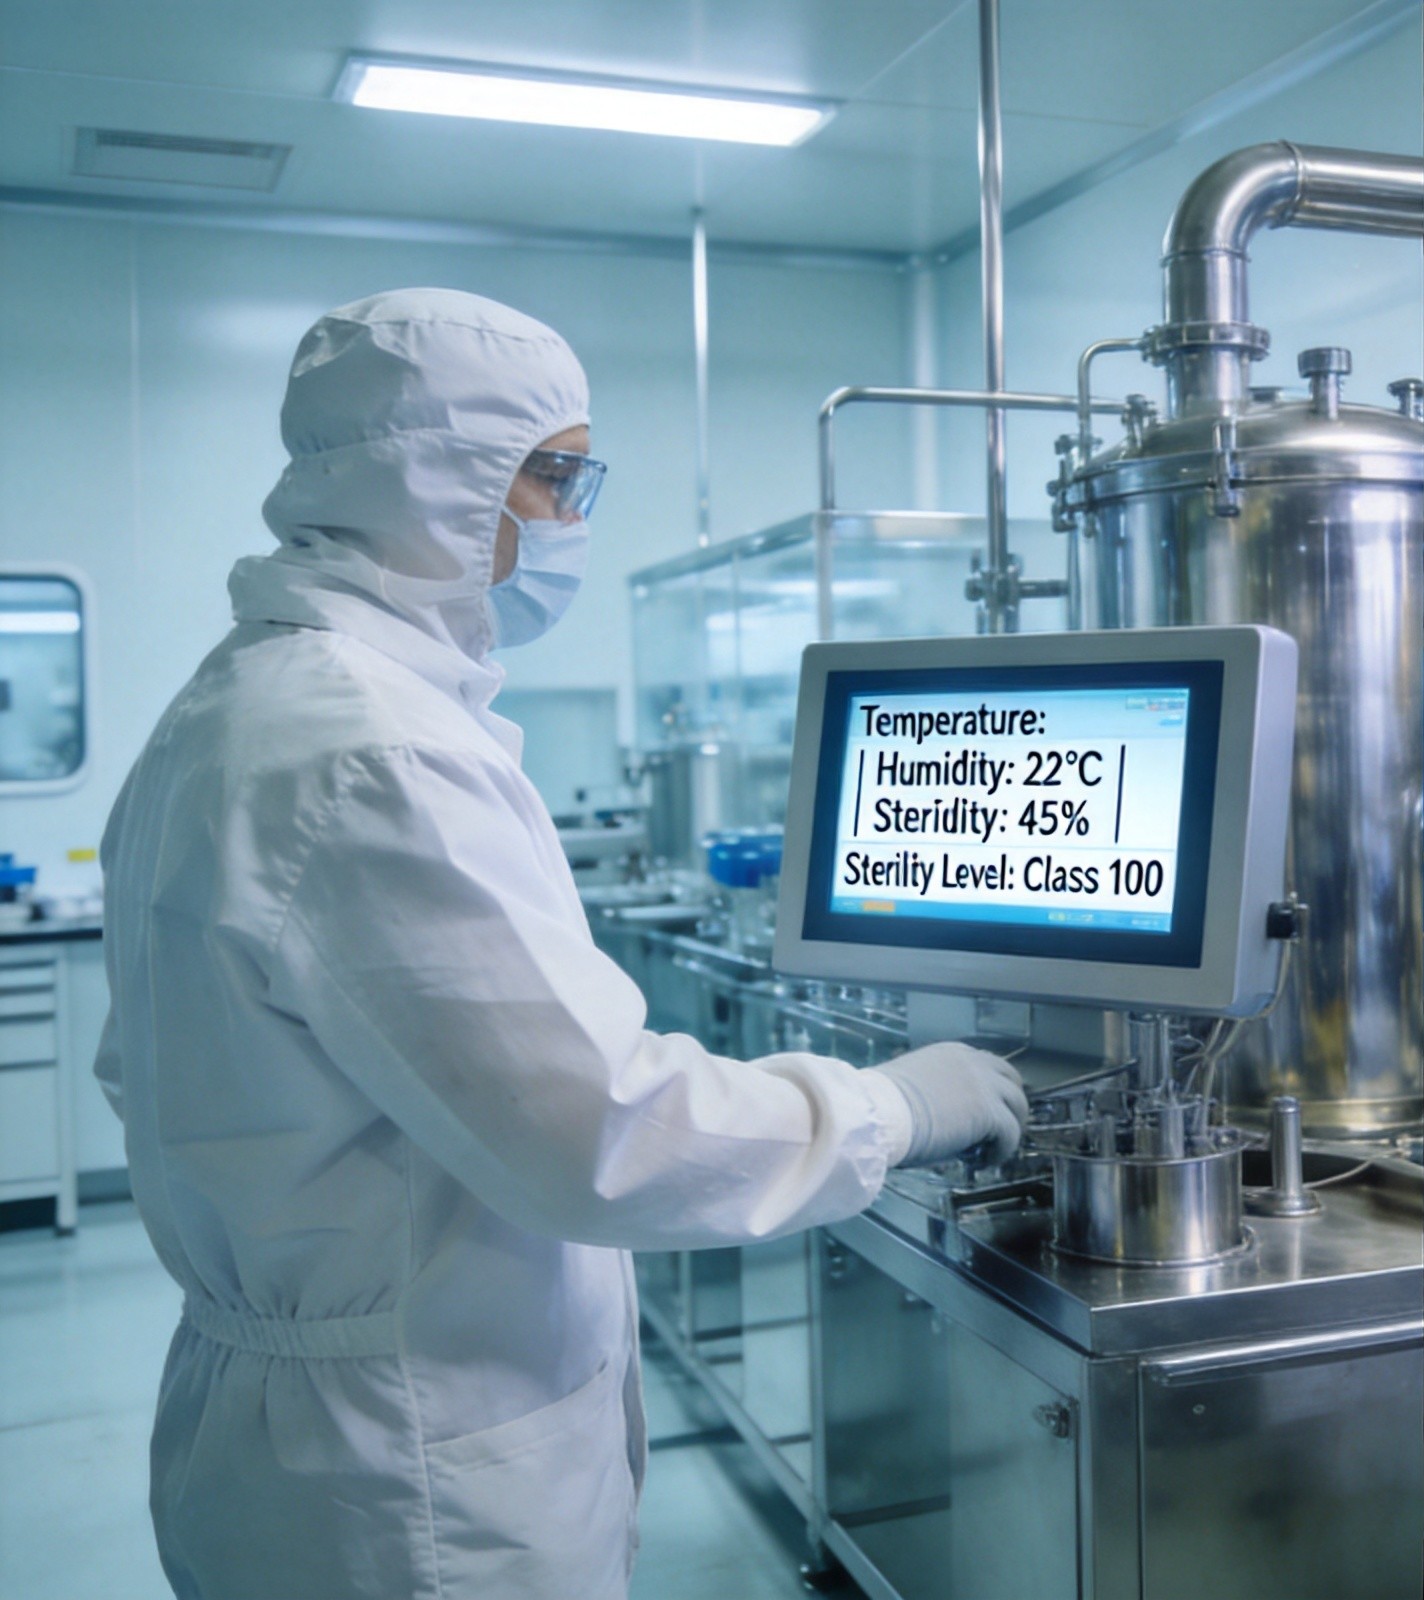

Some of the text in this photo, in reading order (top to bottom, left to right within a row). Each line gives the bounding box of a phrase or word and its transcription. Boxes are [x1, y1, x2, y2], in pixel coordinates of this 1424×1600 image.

[860, 704, 1046, 744] Temperature:
[877, 750, 1102, 795] Humidity: 22°C
[1018, 799, 1089, 835] 45%
[942, 853, 1014, 889] Level:
[1023, 855, 1099, 894] Class
[1109, 858, 1163, 896] 100
